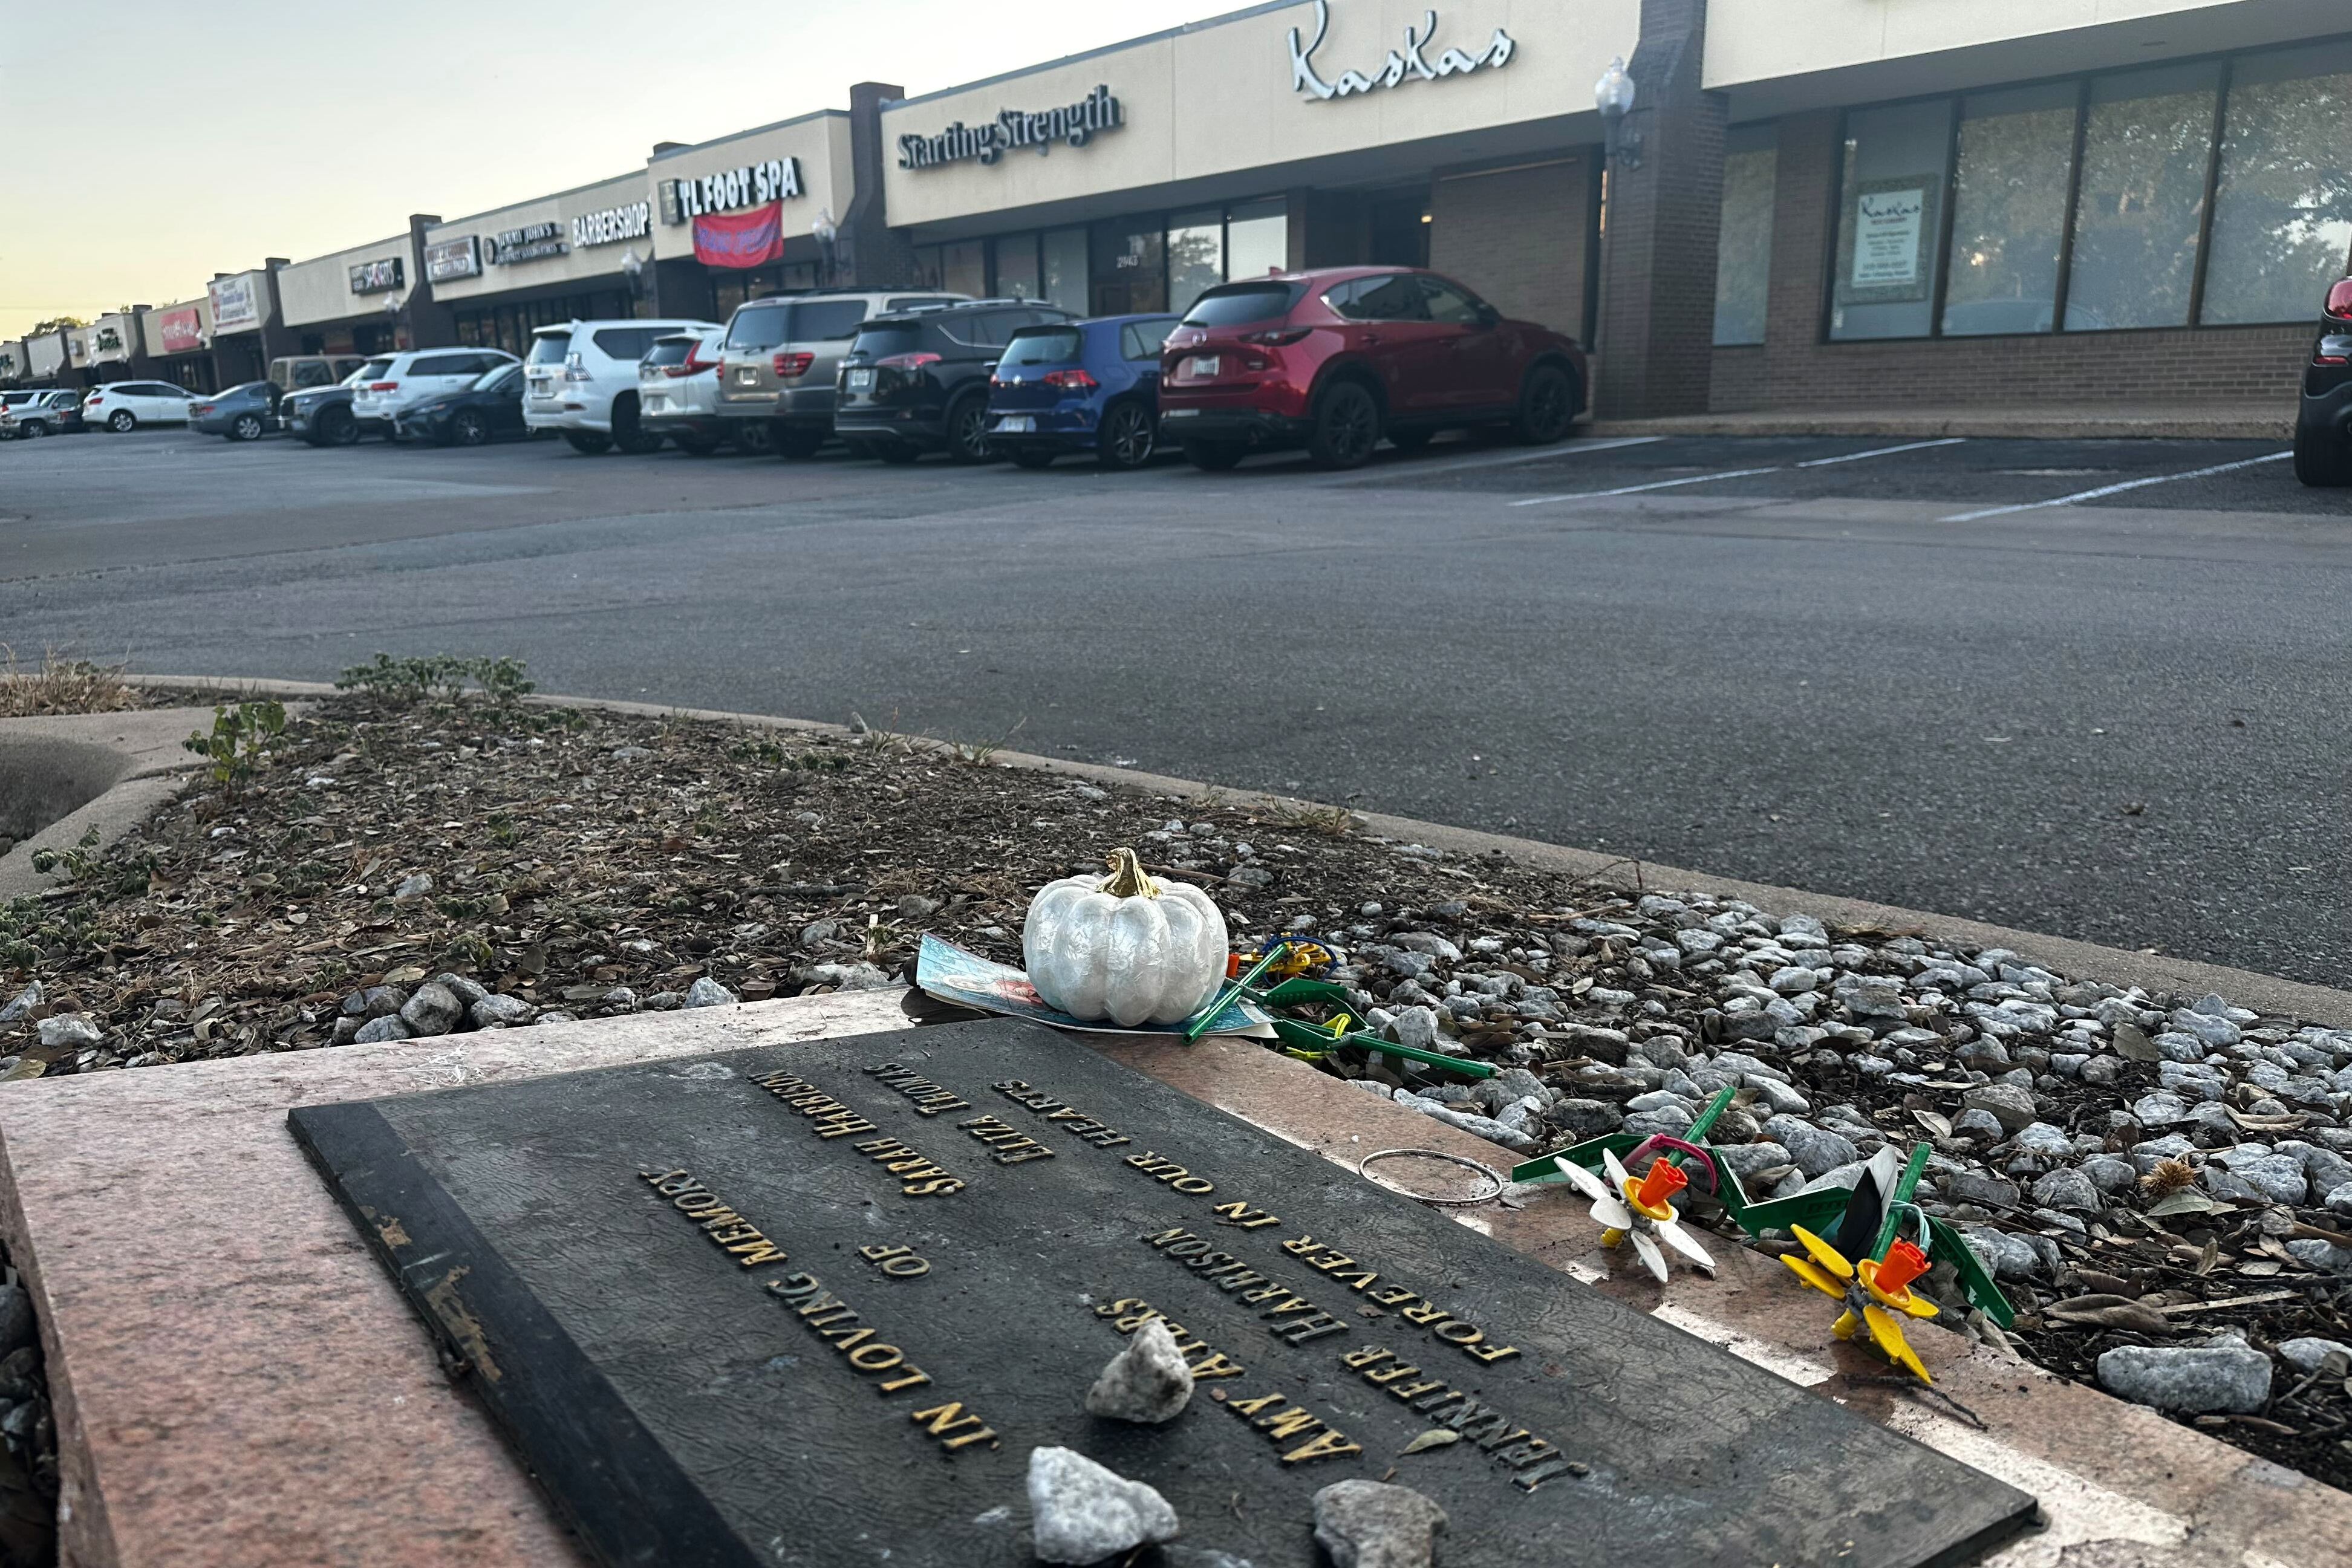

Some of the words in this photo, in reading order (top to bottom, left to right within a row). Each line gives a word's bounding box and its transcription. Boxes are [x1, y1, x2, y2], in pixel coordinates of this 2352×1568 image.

[897, 122, 997, 170] Starting
[997, 84, 1115, 149] Strength
[679, 180, 702, 218] TL
[701, 166, 751, 213] FOOT
[754, 155, 799, 203] SPA
[572, 201, 648, 248] BARBERSHOP
[363, 259, 394, 290] SPORTS
[748, 1070, 877, 1139] HARBISON
[862, 1063, 971, 1116] THOMAS
[991, 1078, 1131, 1148] HEARTS
[853, 1137, 965, 1197] SARAH
[1124, 1150, 1213, 1194] OUR
[639, 1169, 787, 1267] MEMORY
[1213, 1201, 1279, 1228] IN
[859, 1244, 931, 1279] OF
[1281, 1234, 1521, 1365] FOREVER
[767, 1272, 932, 1394] LOVING
[912, 1401, 1000, 1450] IN
[1226, 1391, 1363, 1465] AMY
[1343, 1345, 1589, 1491] JENNIFER
